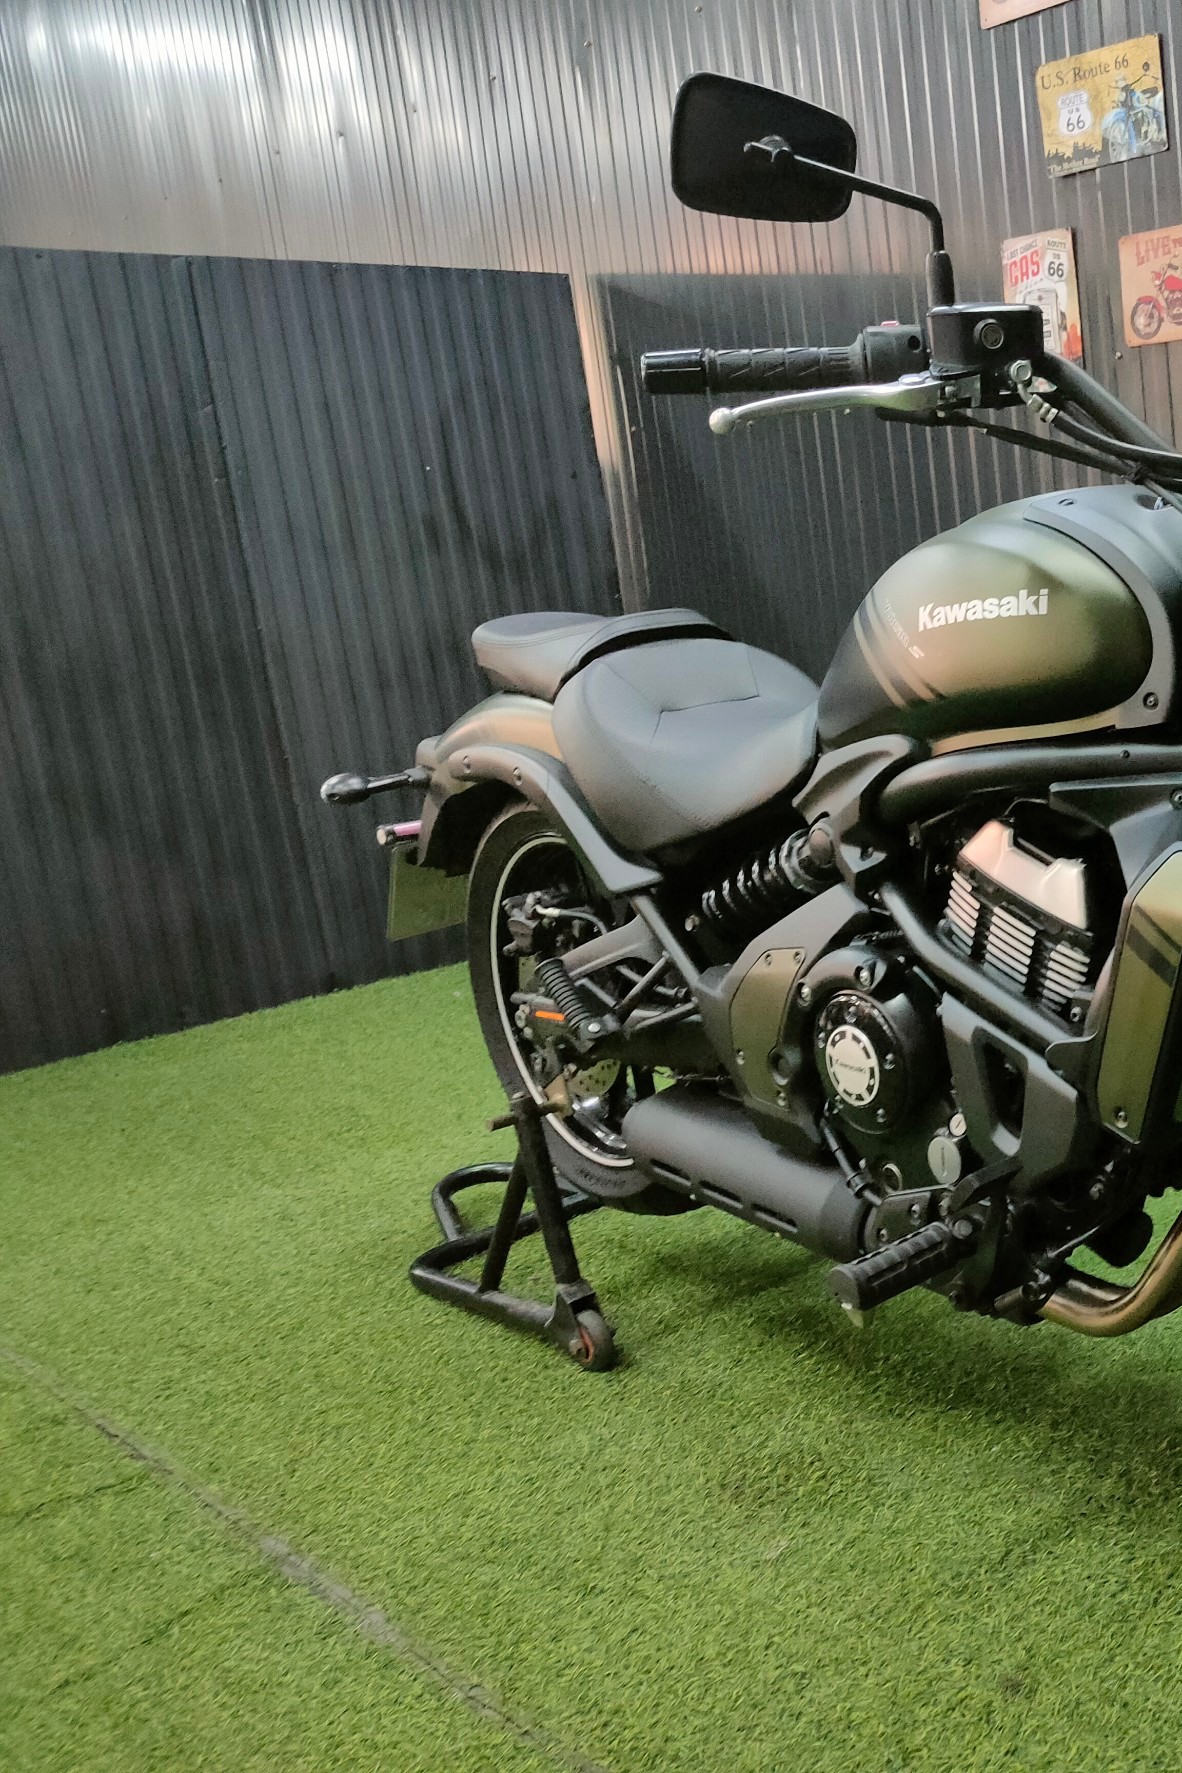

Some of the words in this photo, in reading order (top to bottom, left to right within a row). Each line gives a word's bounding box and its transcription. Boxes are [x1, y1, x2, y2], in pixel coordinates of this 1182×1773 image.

[1041, 70, 1069, 90] U.S.
[1072, 62, 1111, 84] Route
[1114, 53, 1129, 70] 66
[1060, 93, 1085, 106] ROUTE
[1066, 114, 1086, 132] 66
[1047, 239, 1067, 249] ROUTE
[1135, 234, 1171, 267] LIVE
[1006, 248, 1019, 260] LAST
[1009, 249, 1041, 288] GAS
[1048, 261, 1065, 278] 66
[918, 588, 1049, 632] Kawasaki
